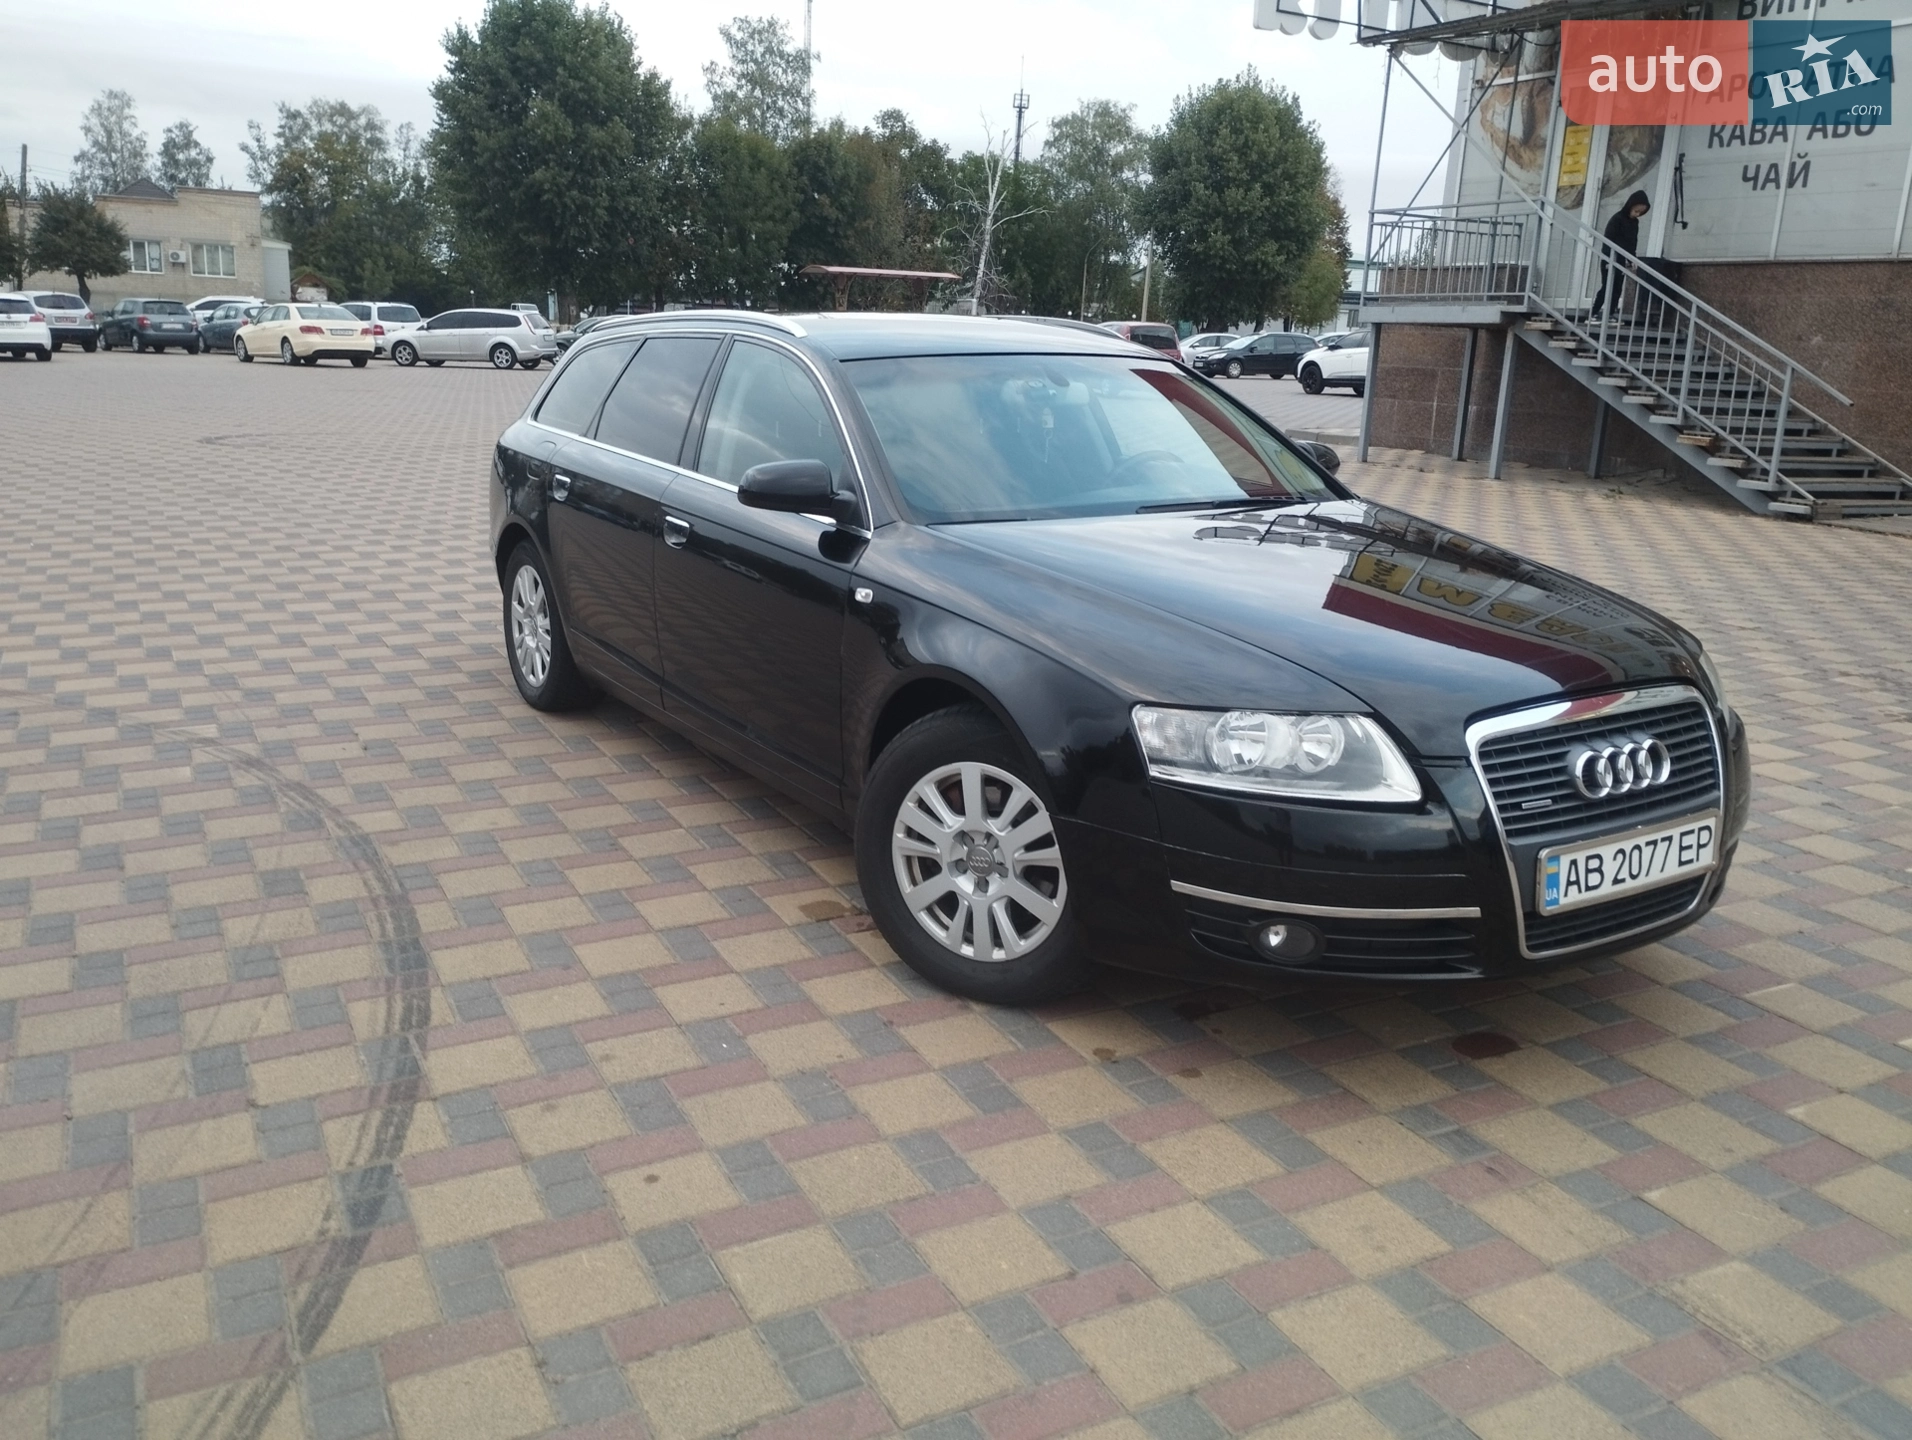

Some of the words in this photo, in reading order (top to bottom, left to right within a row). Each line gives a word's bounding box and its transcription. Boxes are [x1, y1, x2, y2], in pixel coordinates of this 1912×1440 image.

[1707, 115, 1789, 149] КАВА
[1806, 107, 1878, 141] АБО
[1741, 152, 1811, 191] ЧАЙ
[1564, 854, 1604, 897] AB
[1612, 835, 1673, 885] 2077
[1677, 824, 1713, 868] EP
